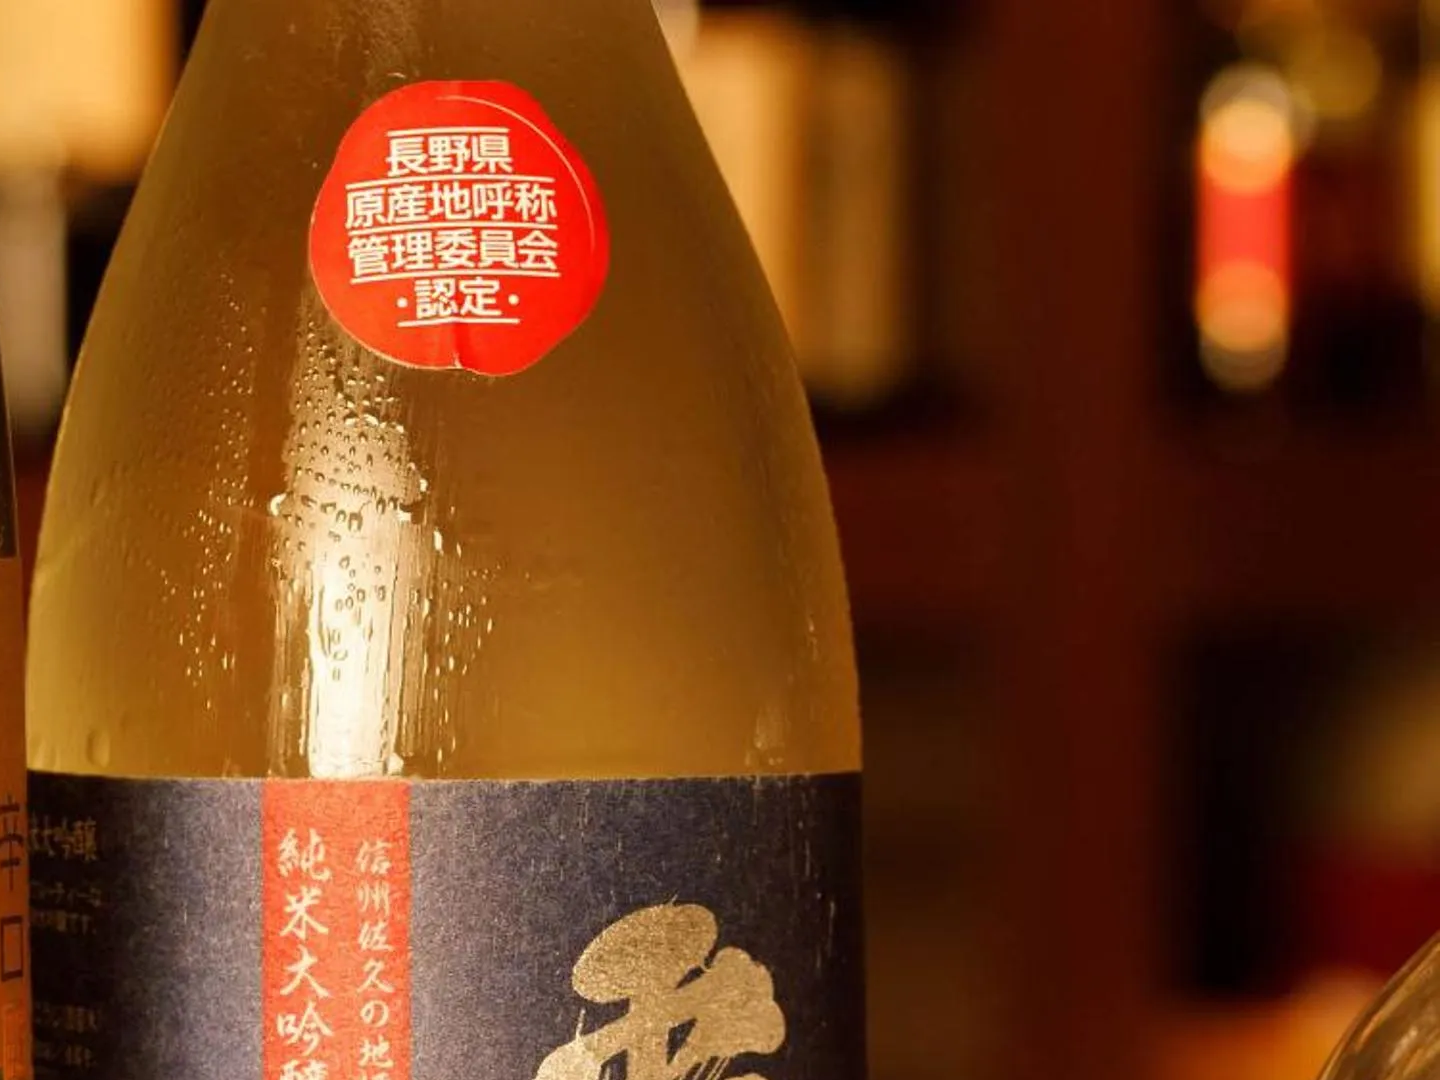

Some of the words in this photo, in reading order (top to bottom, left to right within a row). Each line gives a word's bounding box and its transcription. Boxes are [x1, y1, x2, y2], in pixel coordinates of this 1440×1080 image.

[386, 134, 513, 177] 長野県
[345, 181, 558, 229] 原産地呼称
[347, 228, 558, 277] 管理委員会
